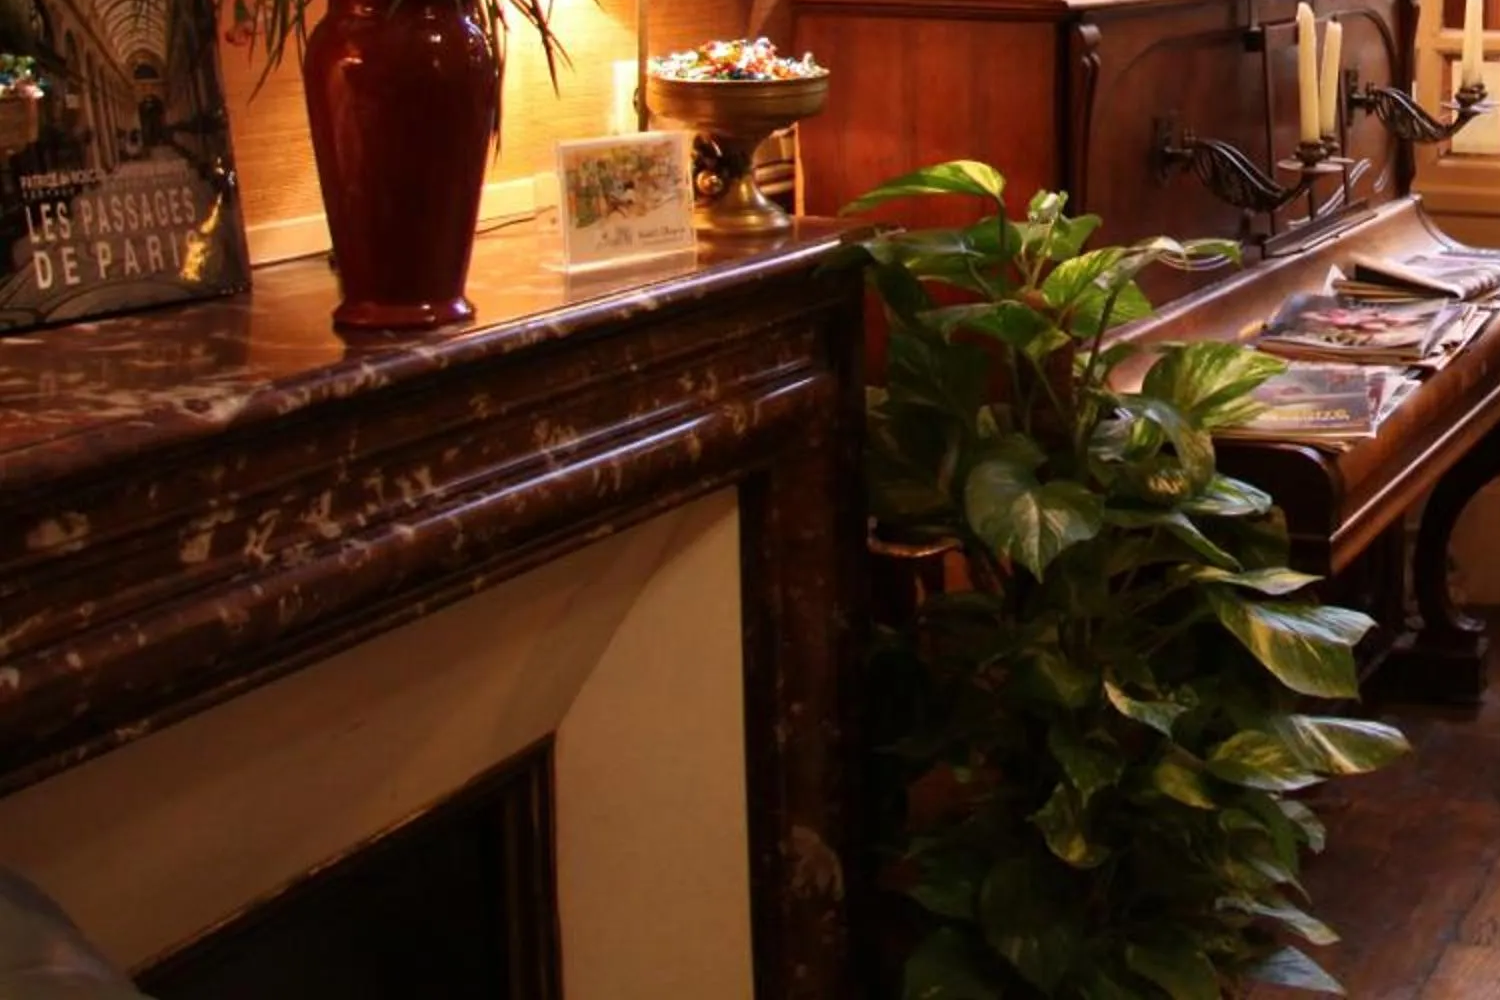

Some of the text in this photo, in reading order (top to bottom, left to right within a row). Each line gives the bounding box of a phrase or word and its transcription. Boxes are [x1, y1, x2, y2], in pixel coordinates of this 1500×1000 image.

[26, 187, 196, 243] LES PASSAGES
[34, 246, 81, 290] DE
